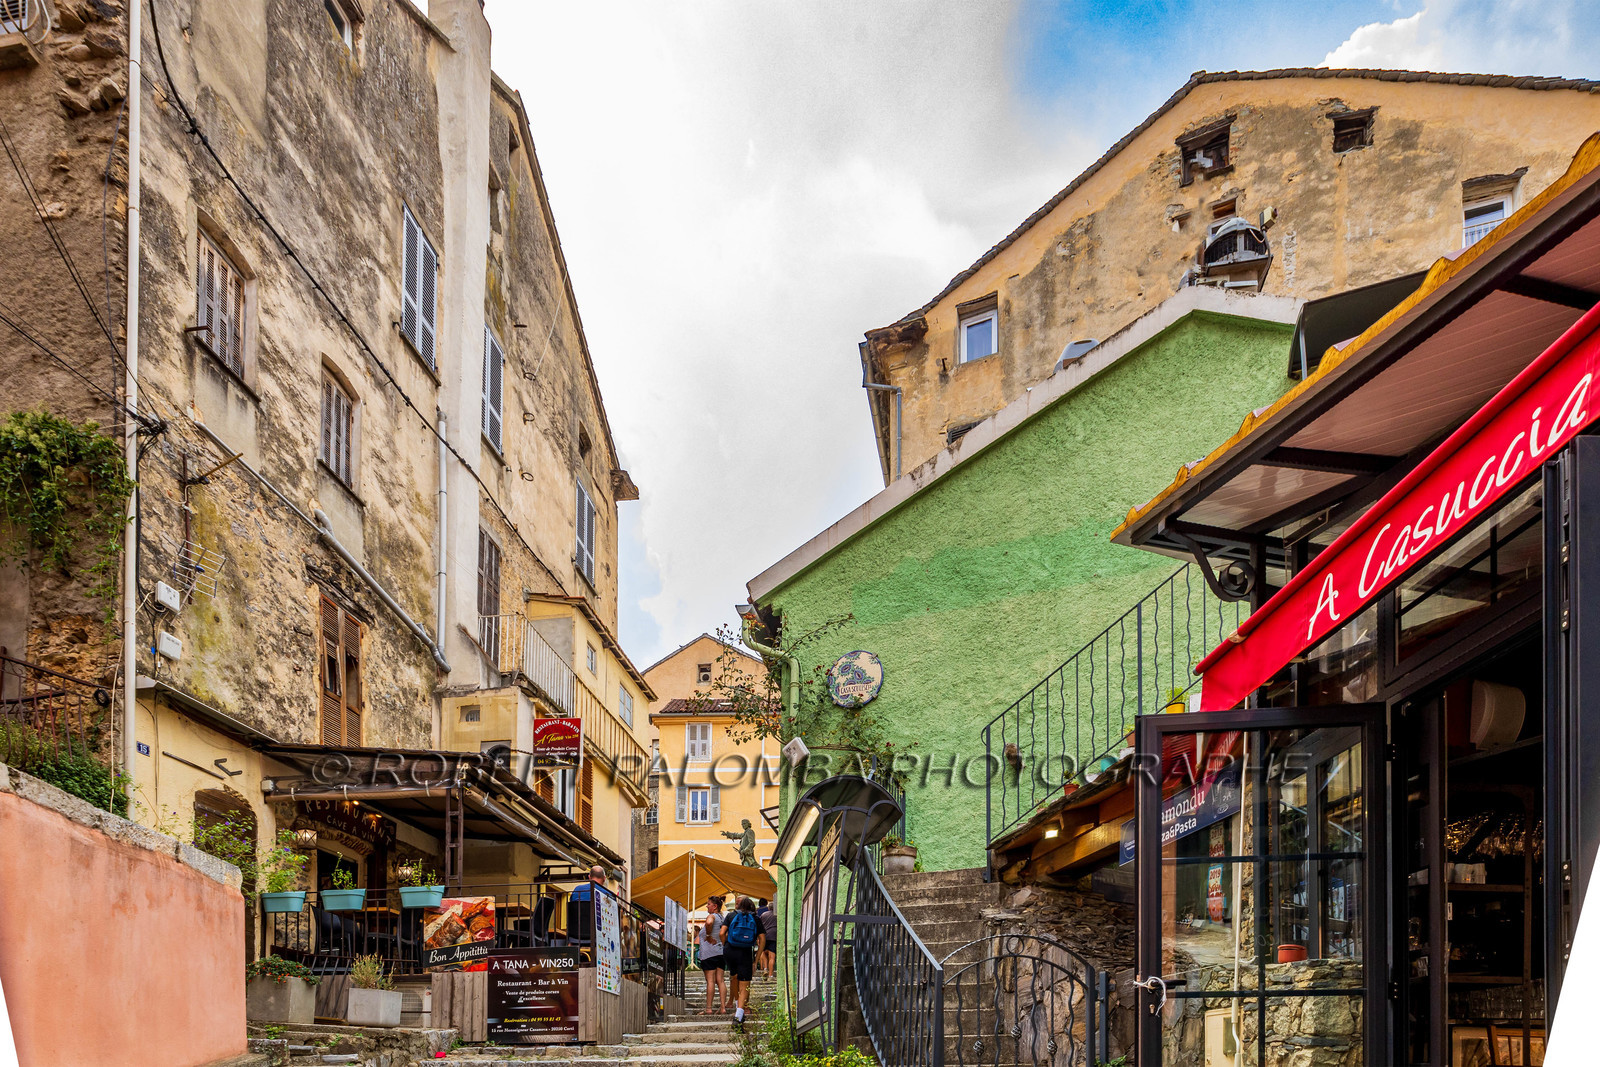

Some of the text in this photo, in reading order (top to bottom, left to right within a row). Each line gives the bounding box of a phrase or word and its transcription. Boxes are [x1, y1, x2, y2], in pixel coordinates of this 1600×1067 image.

[1306, 373, 1592, 641] A Casuccia
[535, 720, 560, 734] RESTAURANT
[535, 734, 547, 747] A
[547, 732, 564, 744] Tana
[305, 800, 392, 846] RESTAURANT
[326, 814, 348, 830] CAVE
[429, 950, 447, 964] Bon
[493, 961, 500, 970] A
[503, 960, 529, 970] TANA
[539, 958, 574, 969] VIN250
